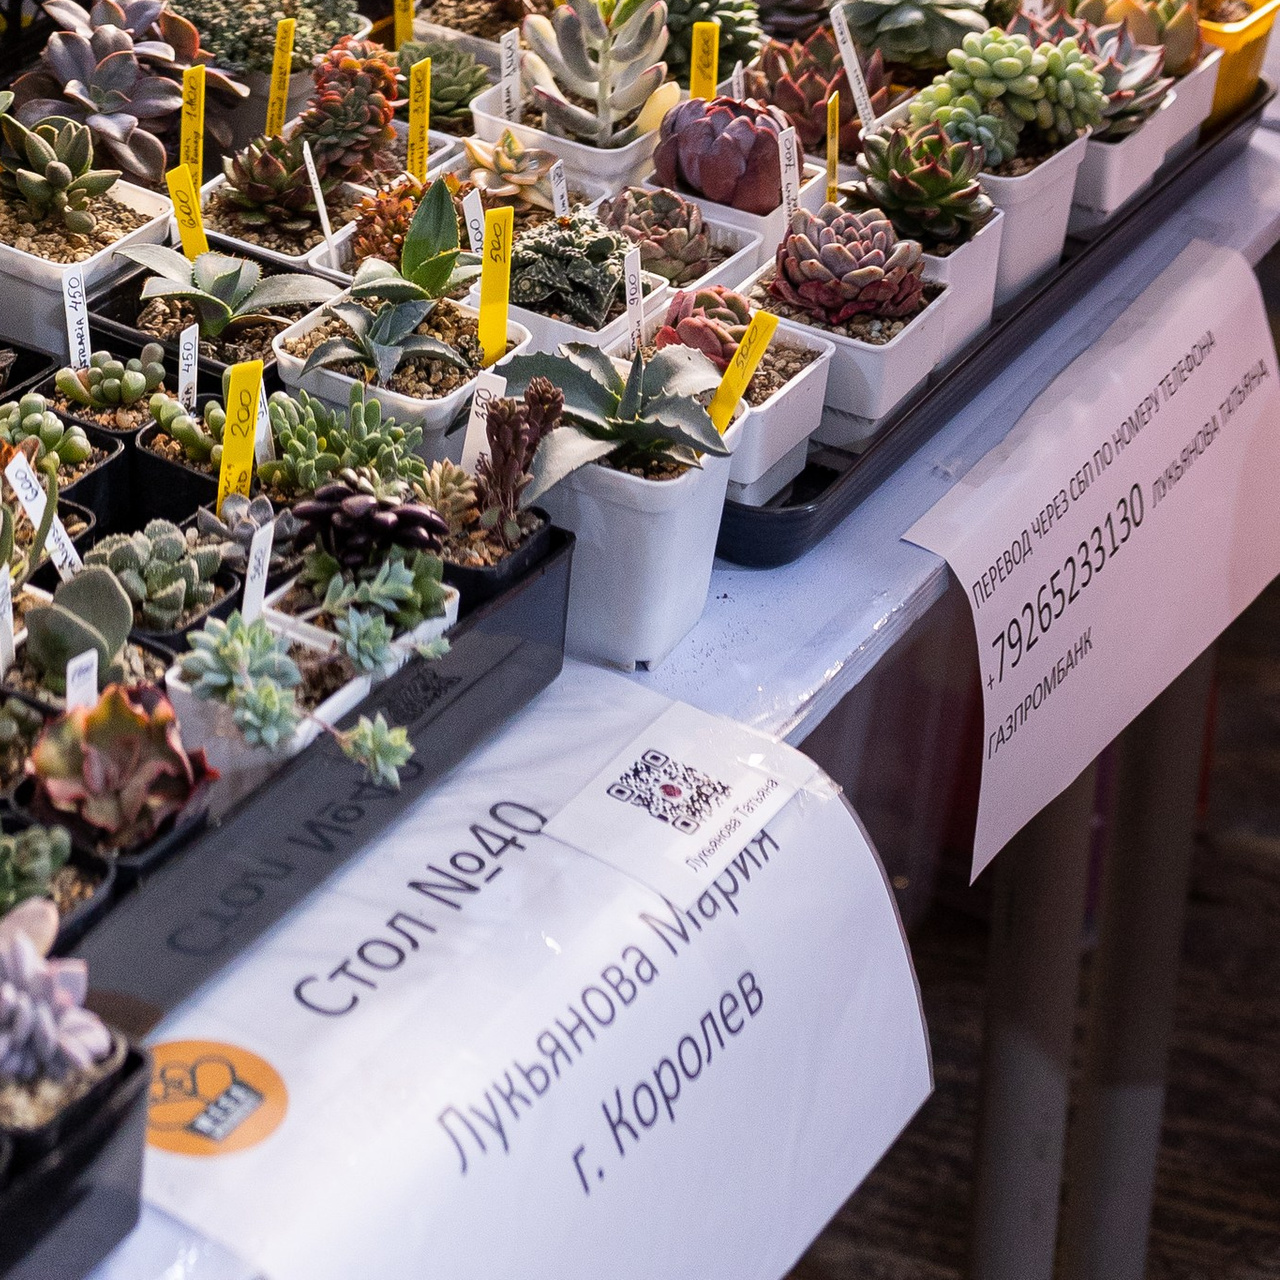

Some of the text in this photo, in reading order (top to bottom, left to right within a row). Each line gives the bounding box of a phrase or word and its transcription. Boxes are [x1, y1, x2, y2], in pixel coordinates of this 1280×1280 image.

[180, 189, 197, 231] 600
[491, 221, 504, 264] 500
[66, 275, 81, 313] 450
[627, 273, 639, 307] 900
[181, 341, 194, 374] 450
[735, 324, 759, 369] 500
[231, 388, 254, 439] 200
[476, 387, 493, 421] 350
[14, 468, 40, 502] 600
[972, 330, 1217, 610] ПЕРЕВОД ЧЕРЕЗ СБП ПО НОМЕРУ ТЕЛЕФОНА
[987, 358, 1269, 691] +79265233130 ЛУКЬЯНОВА ТАТЬЯНА
[987, 625, 1093, 760] ГАЗПРОМБАНК
[685, 778, 779, 873] Лукьянова Татьяна
[293, 800, 549, 1018] Стол №40
[437, 828, 780, 1176] Лукьянова Мария
[572, 970, 764, 1197] г. Королев
